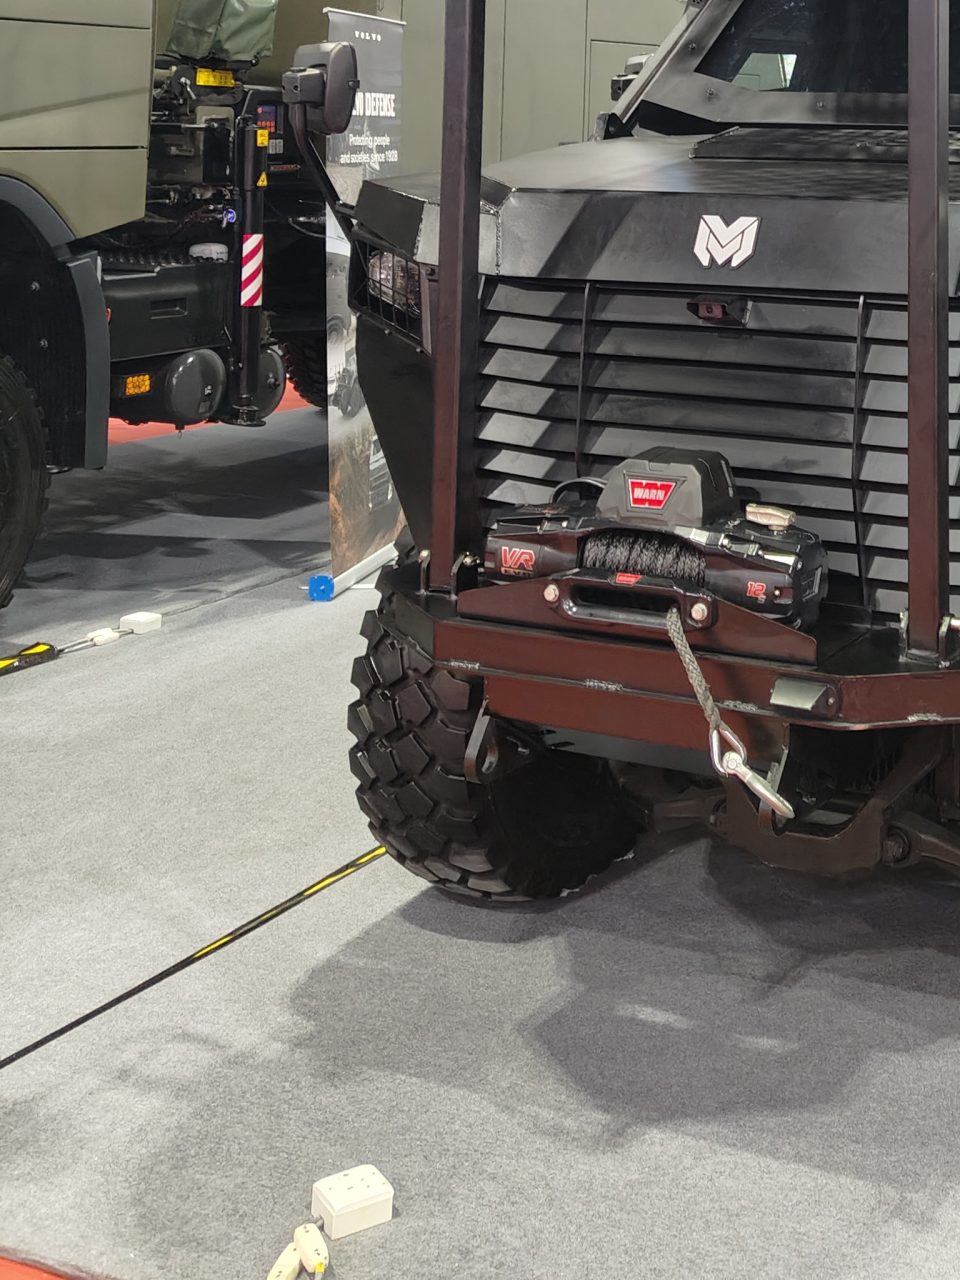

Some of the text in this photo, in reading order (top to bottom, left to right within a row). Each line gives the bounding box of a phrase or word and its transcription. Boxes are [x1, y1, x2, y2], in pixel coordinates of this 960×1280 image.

[354, 30, 382, 42] VOLVO
[364, 92, 396, 117] DEFENSE
[349, 133, 390, 148] Protecting people
[340, 152, 351, 164] and
[351, 151, 370, 163] societies
[370, 150, 385, 163] since
[633, 487, 666, 501] WARN
[501, 545, 536, 571] VR
[746, 580, 767, 598] 12
